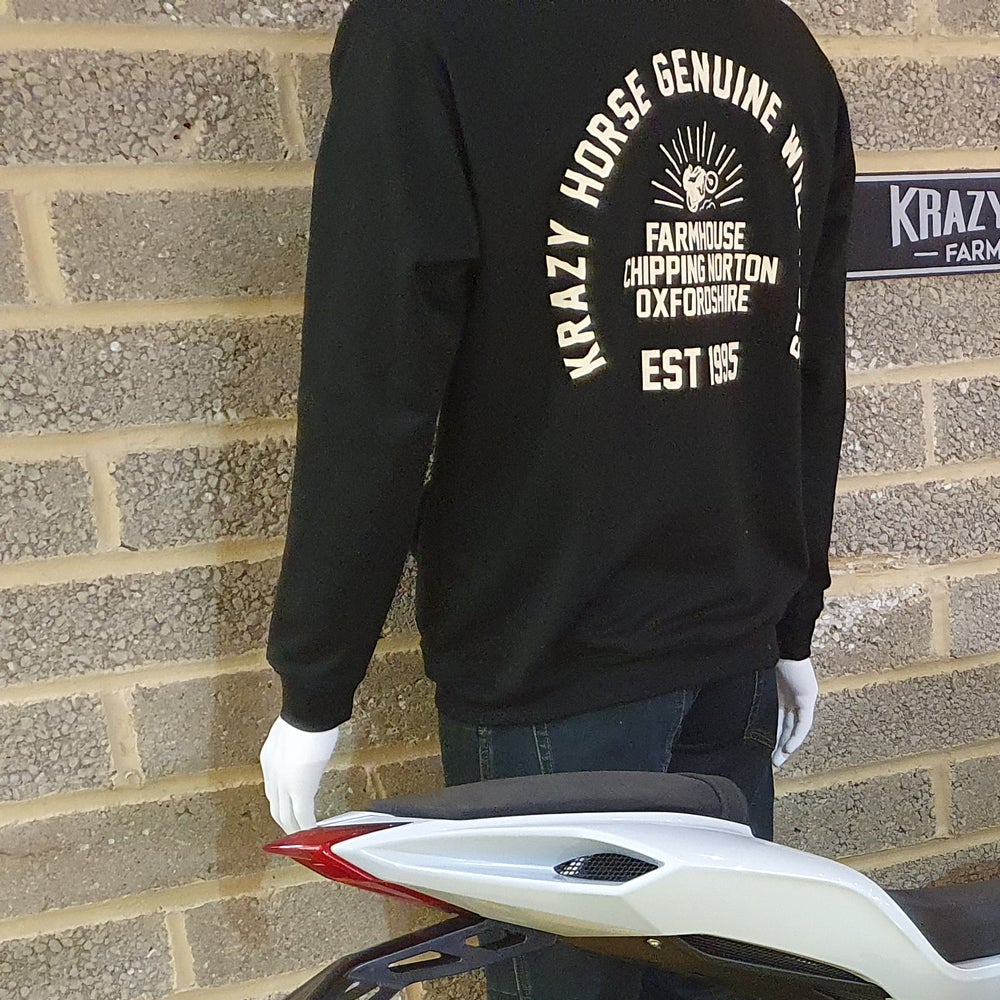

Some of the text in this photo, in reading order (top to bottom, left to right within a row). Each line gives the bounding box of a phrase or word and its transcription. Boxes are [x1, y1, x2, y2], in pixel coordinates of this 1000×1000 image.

[546, 48, 783, 380] KRAZY HORSE GENUINE
[646, 221, 747, 252] FARMHOUSE
[623, 254, 779, 288] CHIPPING NORTON
[636, 284, 750, 319] OXFORDSHIRE
[641, 341, 740, 391] EST 1995
